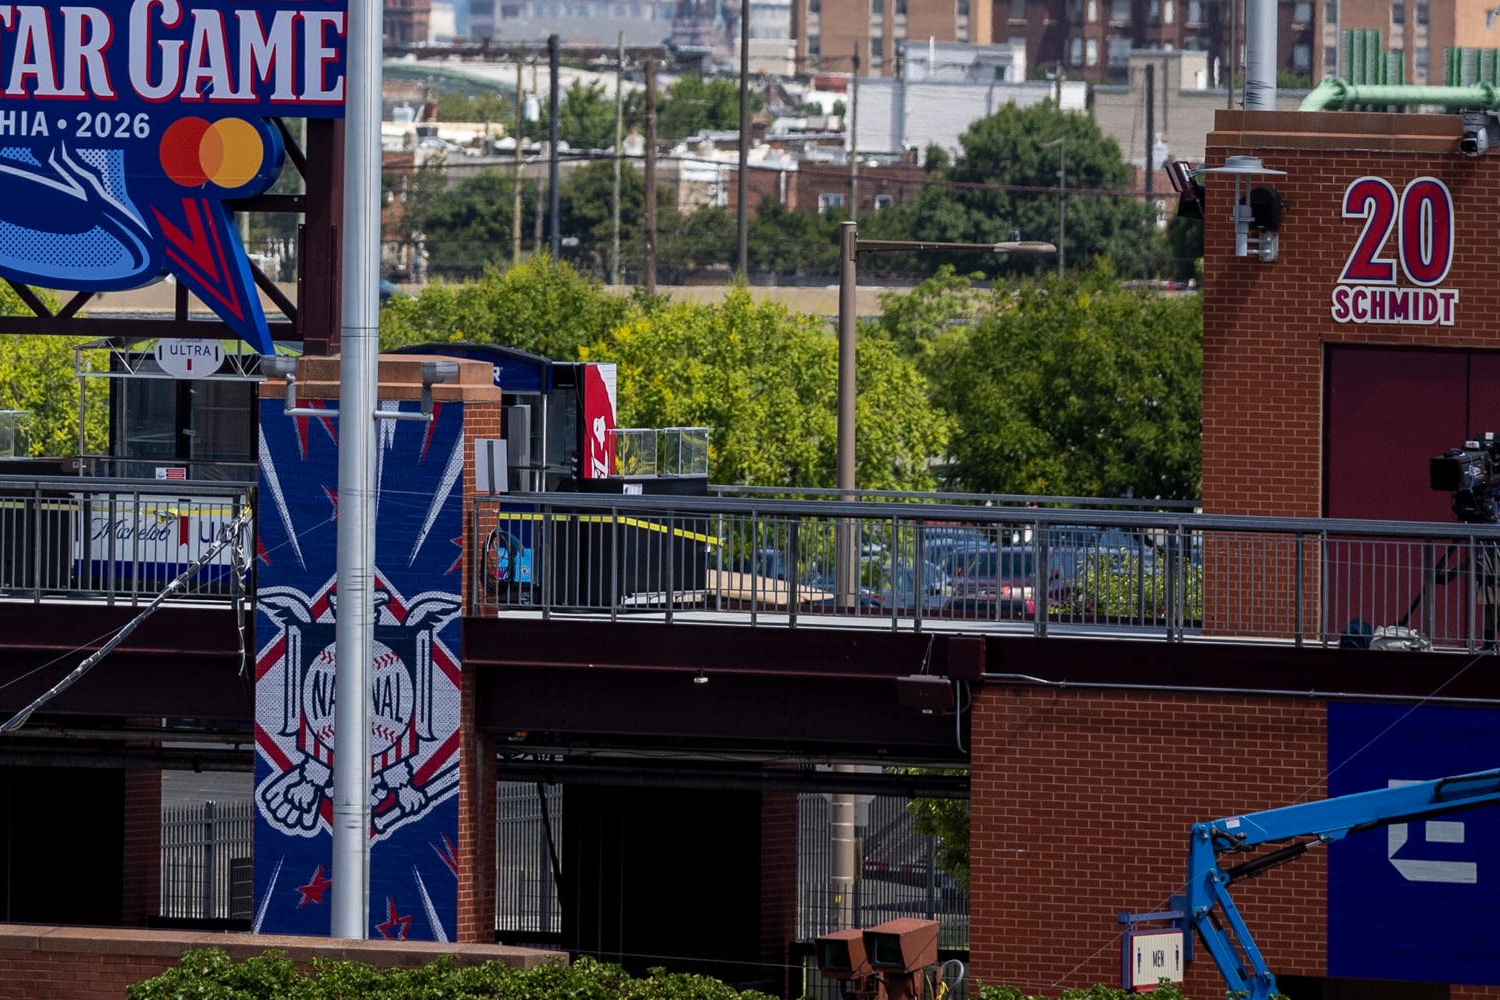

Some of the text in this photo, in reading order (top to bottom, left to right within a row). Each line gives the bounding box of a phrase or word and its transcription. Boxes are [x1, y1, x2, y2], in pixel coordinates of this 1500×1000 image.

[75, 111, 150, 139] 2026
[1338, 176, 1455, 286] 20
[1333, 287, 1457, 324] SCHMIDT
[170, 344, 211, 357] ULTRA
[1153, 950, 1164, 968] MEN
